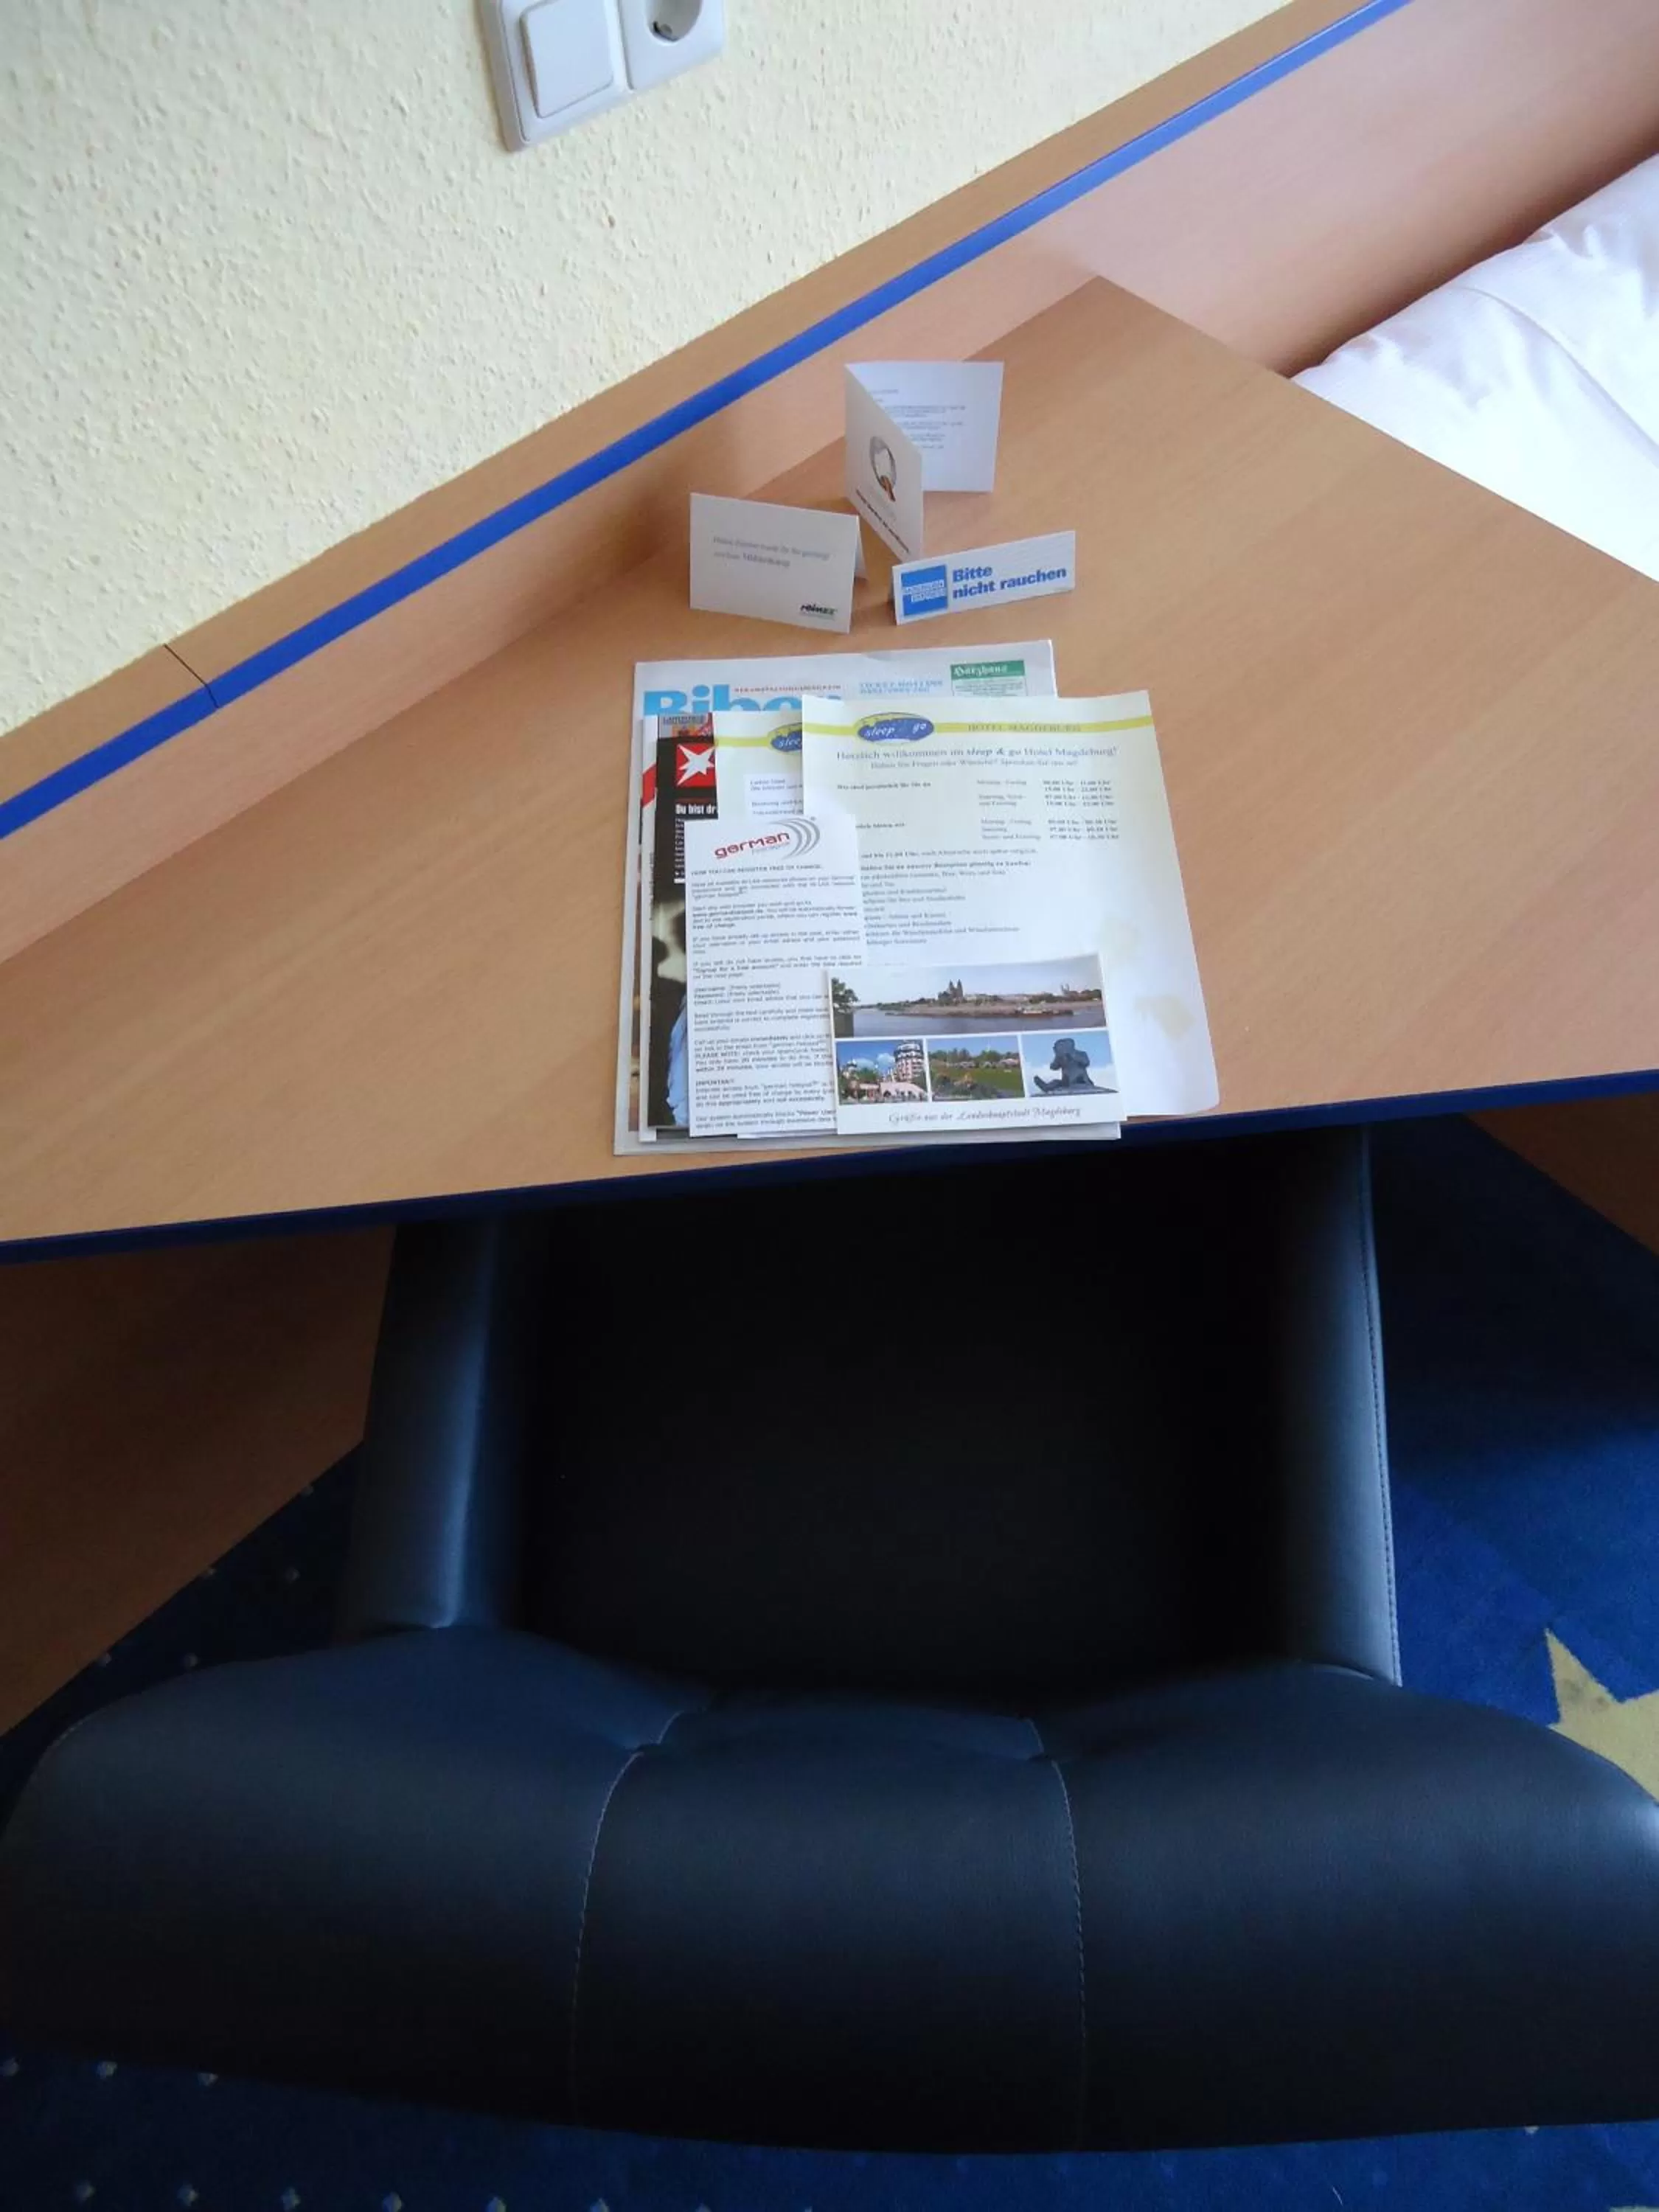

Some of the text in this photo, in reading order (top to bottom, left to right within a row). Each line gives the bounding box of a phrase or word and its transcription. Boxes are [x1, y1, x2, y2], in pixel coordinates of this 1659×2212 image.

[952, 566, 992, 582] Bitte
[952, 567, 1067, 599] nicht rauchen
[864, 723, 927, 737] sleep go
[967, 747, 993, 758] sleep
[1009, 749, 1021, 758] go
[714, 831, 790, 859] german
